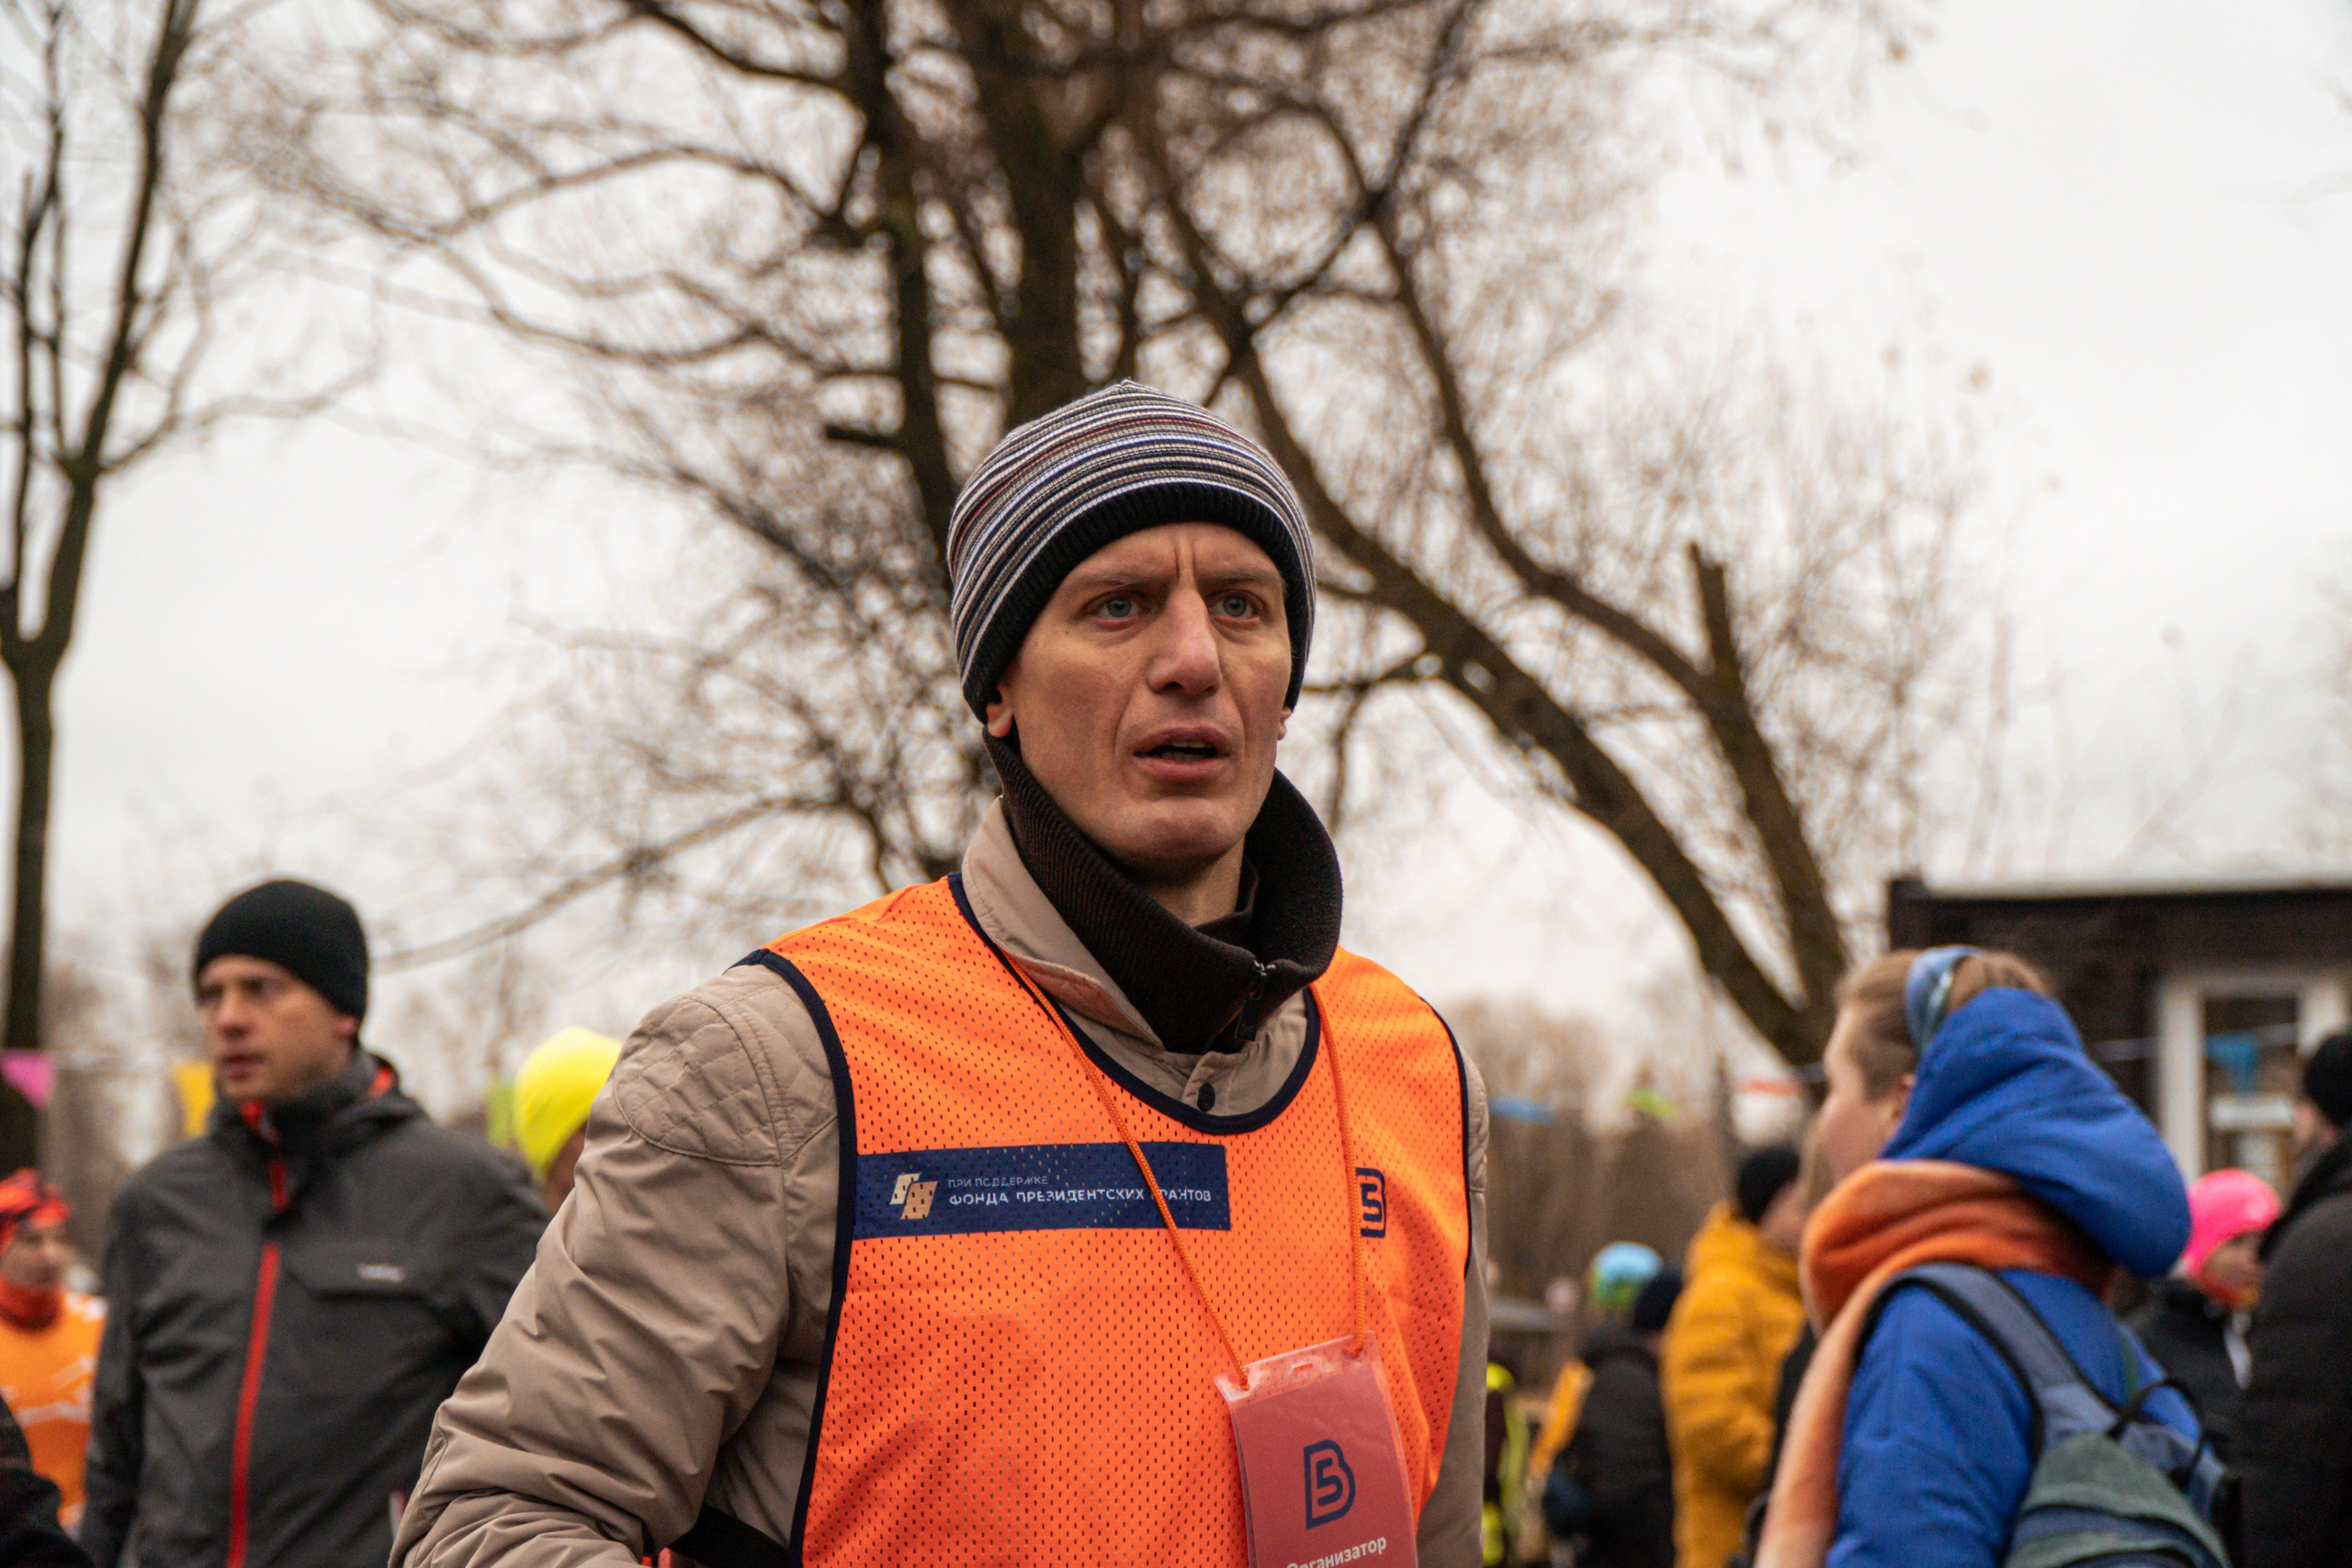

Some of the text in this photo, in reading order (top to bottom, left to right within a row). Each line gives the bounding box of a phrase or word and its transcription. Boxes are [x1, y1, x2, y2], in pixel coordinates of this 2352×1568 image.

[947, 1176, 1048, 1189] ПРИ ПОДДЕРЖКЕ
[949, 1189, 1212, 1206] ФОНДА ПРЕЗИДЕНТСКИХ РАНТОВ
